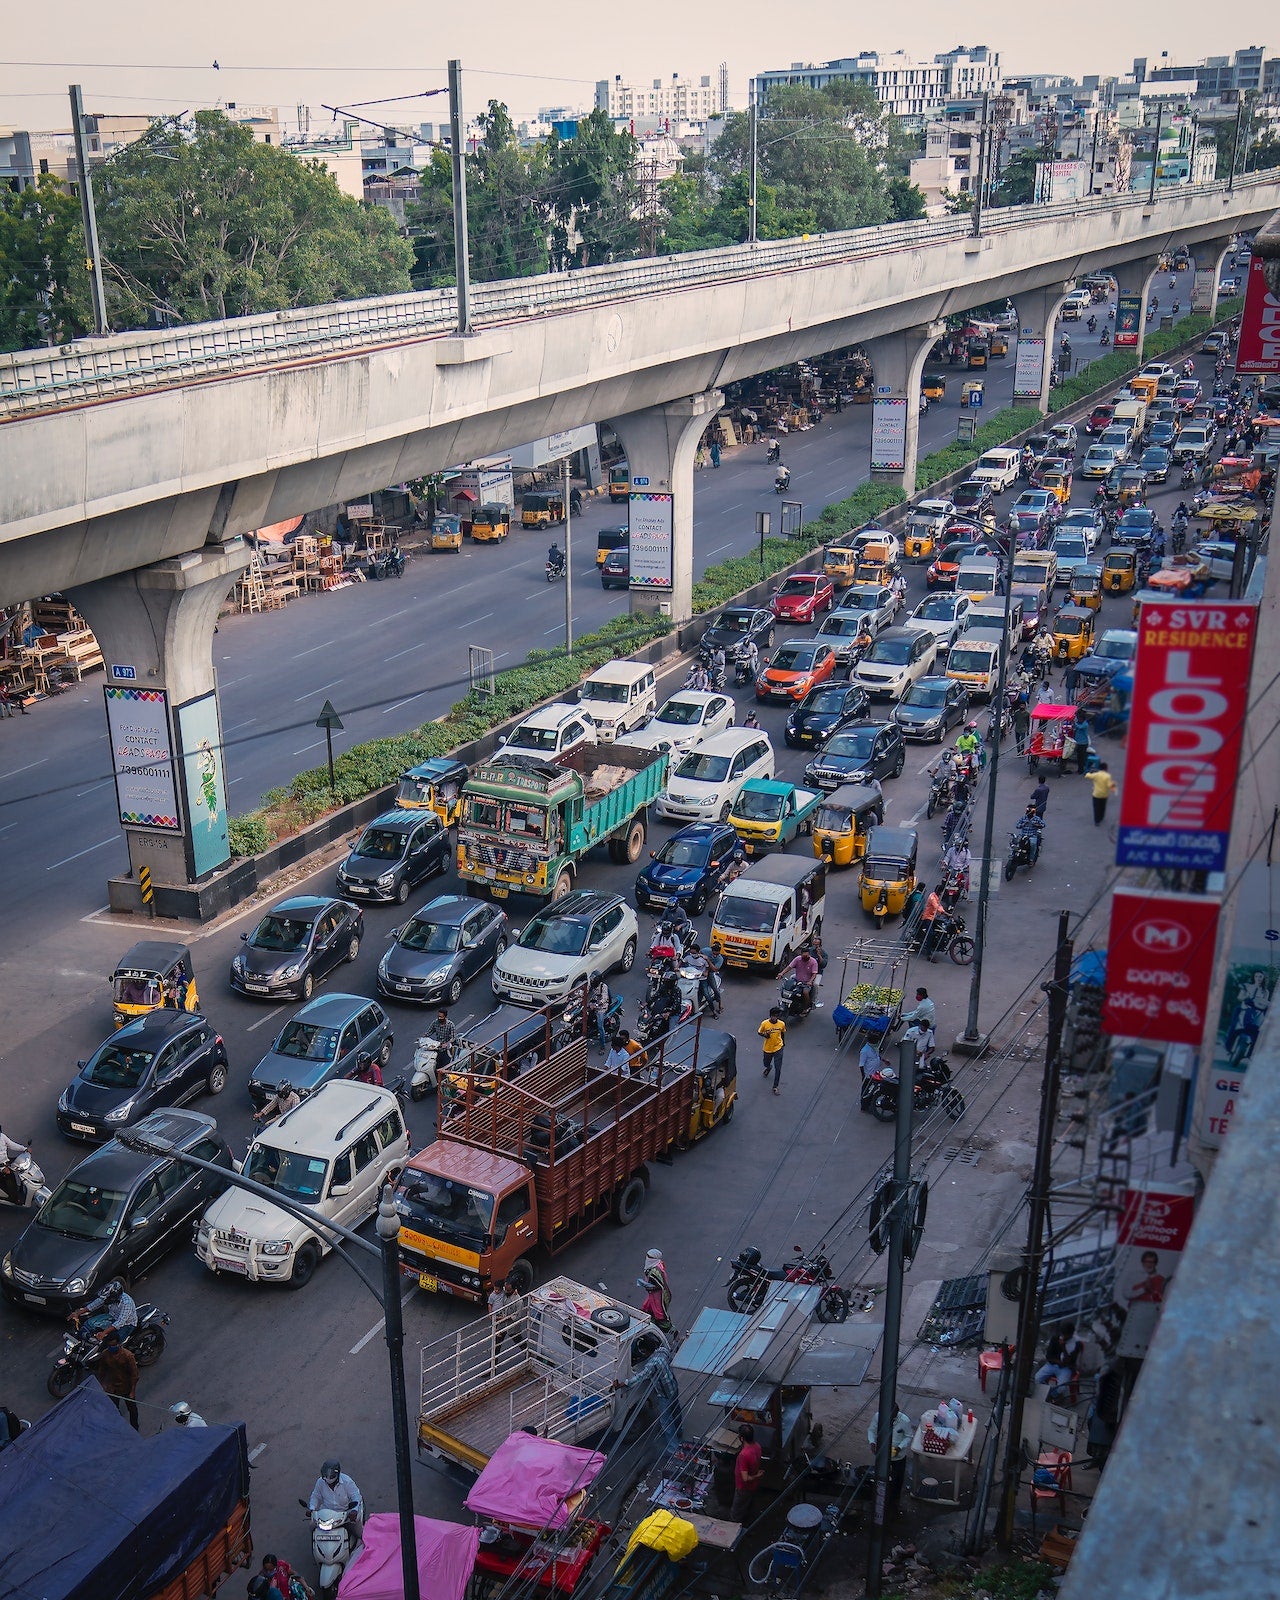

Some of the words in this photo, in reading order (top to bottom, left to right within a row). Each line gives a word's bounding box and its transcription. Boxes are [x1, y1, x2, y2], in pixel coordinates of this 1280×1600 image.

[632, 545, 668, 553] 7396001111
[1169, 609, 1227, 629] SVR
[1145, 630, 1248, 648] RESIDENCE
[116, 668, 121, 676] A
[122, 668, 134, 677] 973
[125, 736, 158, 745] CONTACT
[1142, 651, 1228, 827] LODGE
[120, 765, 170, 778] 7396001111
[725, 935, 741, 943] MINI
[744, 938, 758, 946] TAXI
[404, 1230, 426, 1245] GOODS
